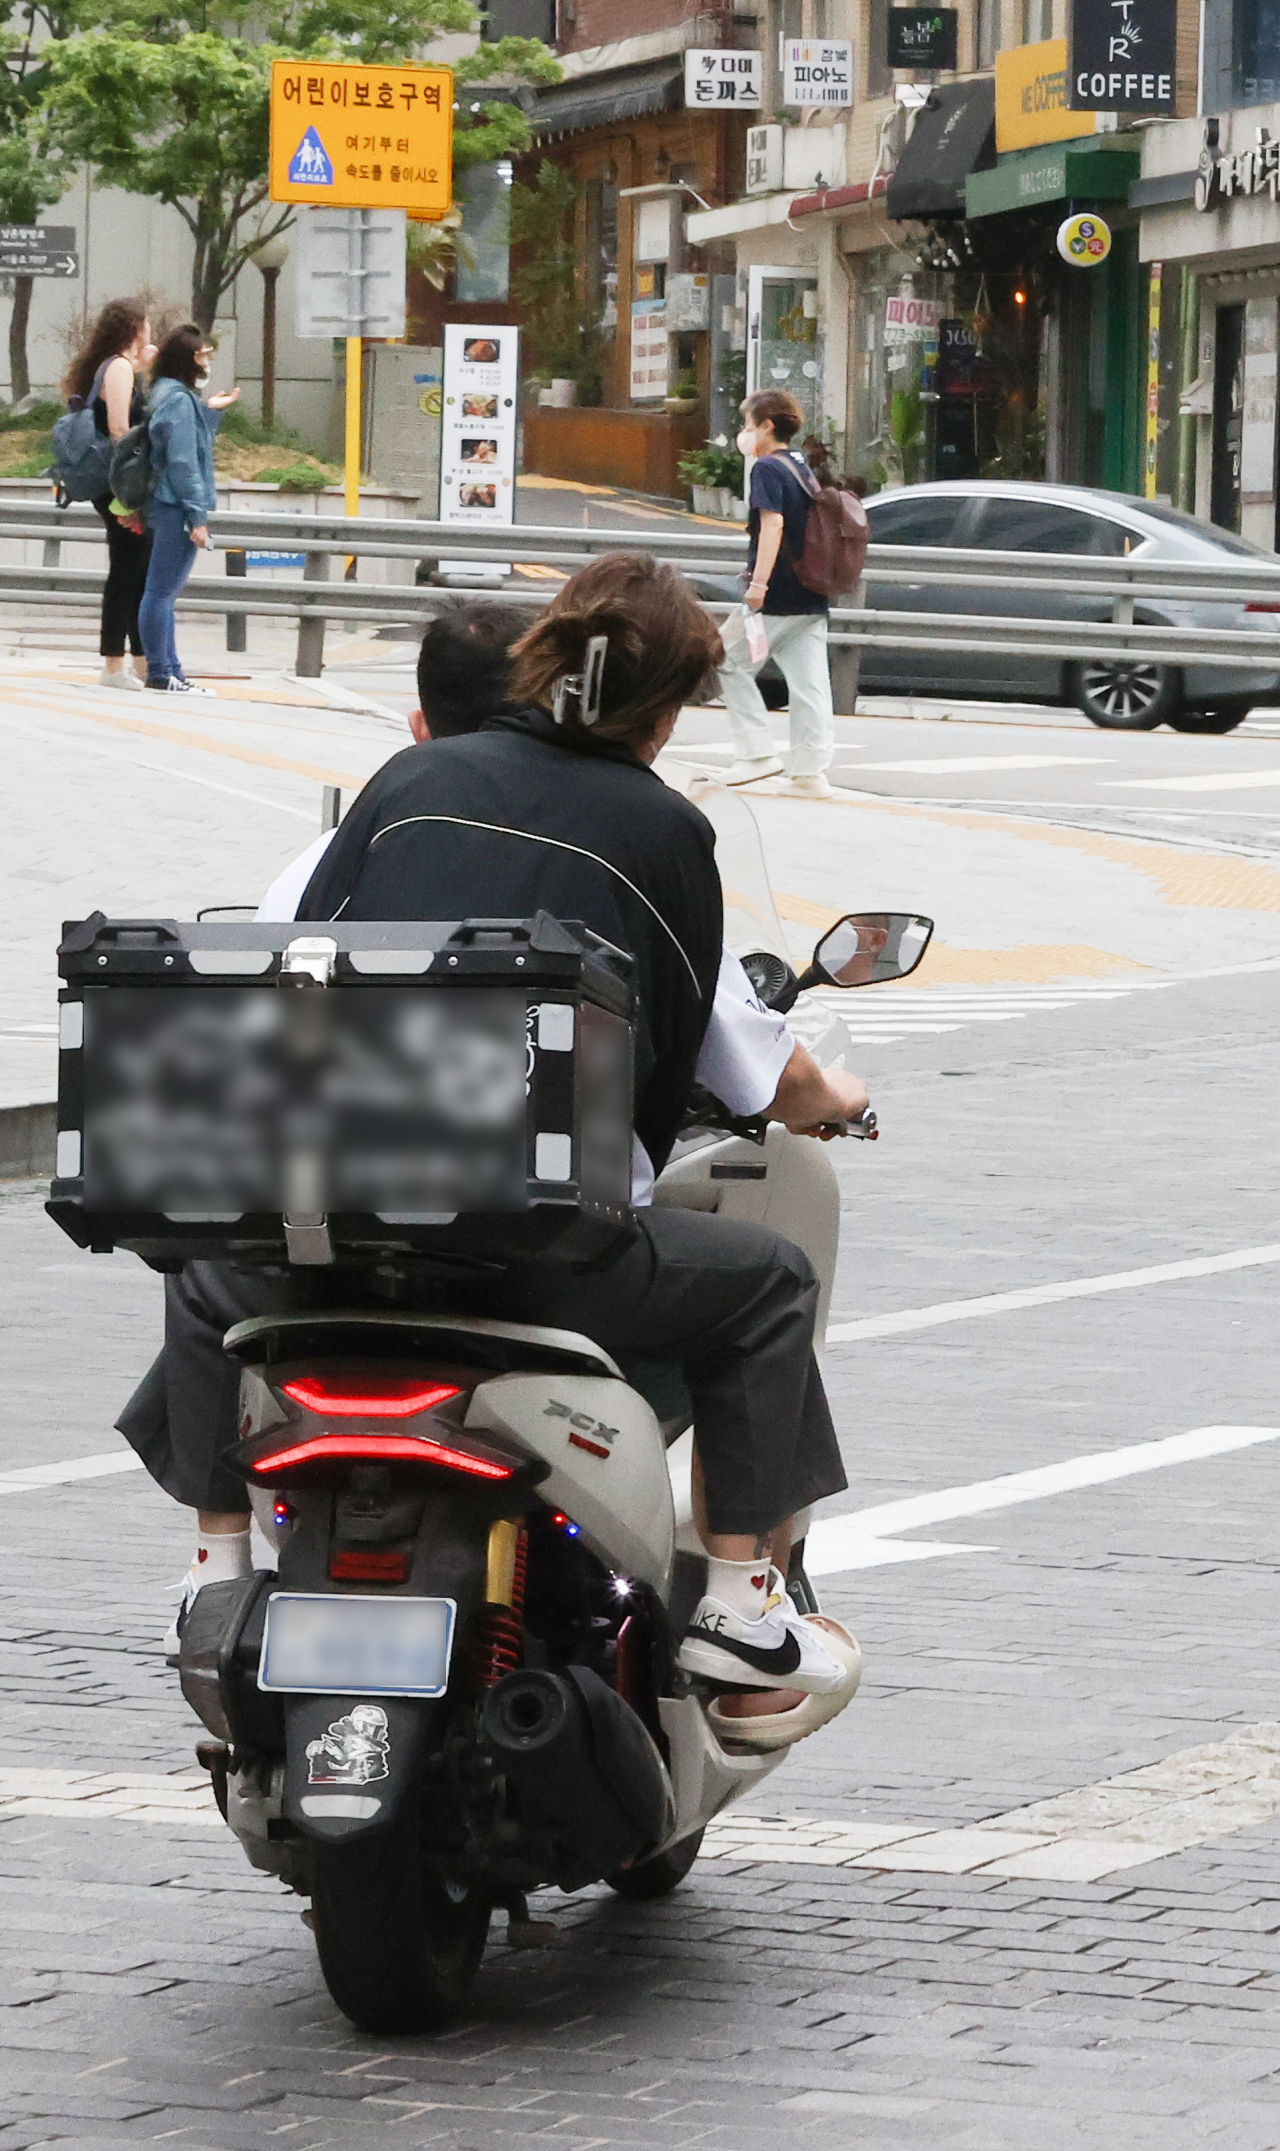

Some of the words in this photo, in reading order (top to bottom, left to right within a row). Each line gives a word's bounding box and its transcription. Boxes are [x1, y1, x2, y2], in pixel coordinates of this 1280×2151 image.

[794, 66, 848, 83] 피아노
[283, 76, 441, 113] 어린이보호구역
[695, 80, 759, 102] 돈까스
[1077, 72, 1170, 99] COFFEE
[346, 135, 409, 153] 여기부터
[346, 164, 382, 181] 속도를
[390, 165, 439, 184] 줄이시오
